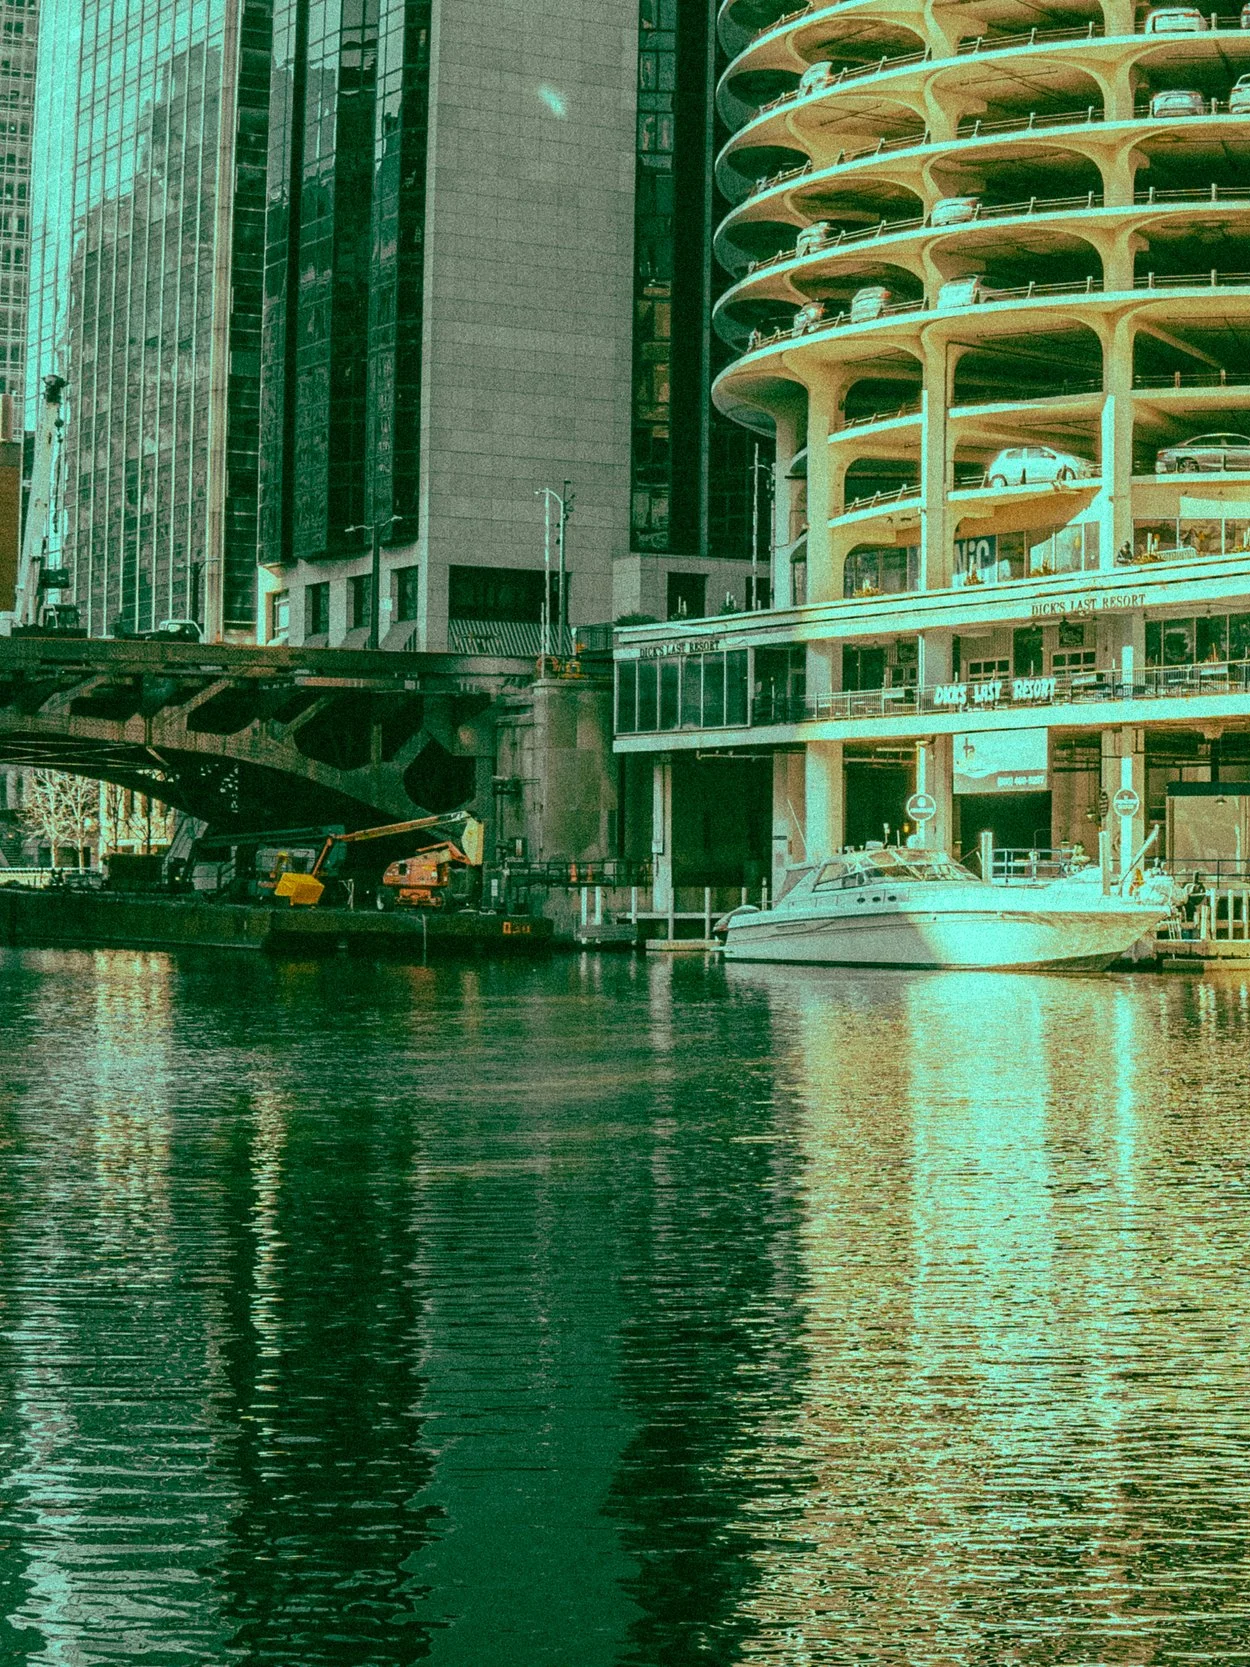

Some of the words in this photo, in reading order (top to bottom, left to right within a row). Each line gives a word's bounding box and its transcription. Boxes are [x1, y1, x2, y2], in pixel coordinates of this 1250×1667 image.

[1031, 601, 1066, 616] DICK'S
[1070, 598, 1098, 612] LAST
[1102, 594, 1146, 609] RESORT
[640, 645, 664, 658] DICK'S
[666, 642, 686, 656] LAST
[689, 639, 720, 654] RESORT
[974, 681, 1002, 703] LAST
[1012, 677, 1057, 700] RESORT
